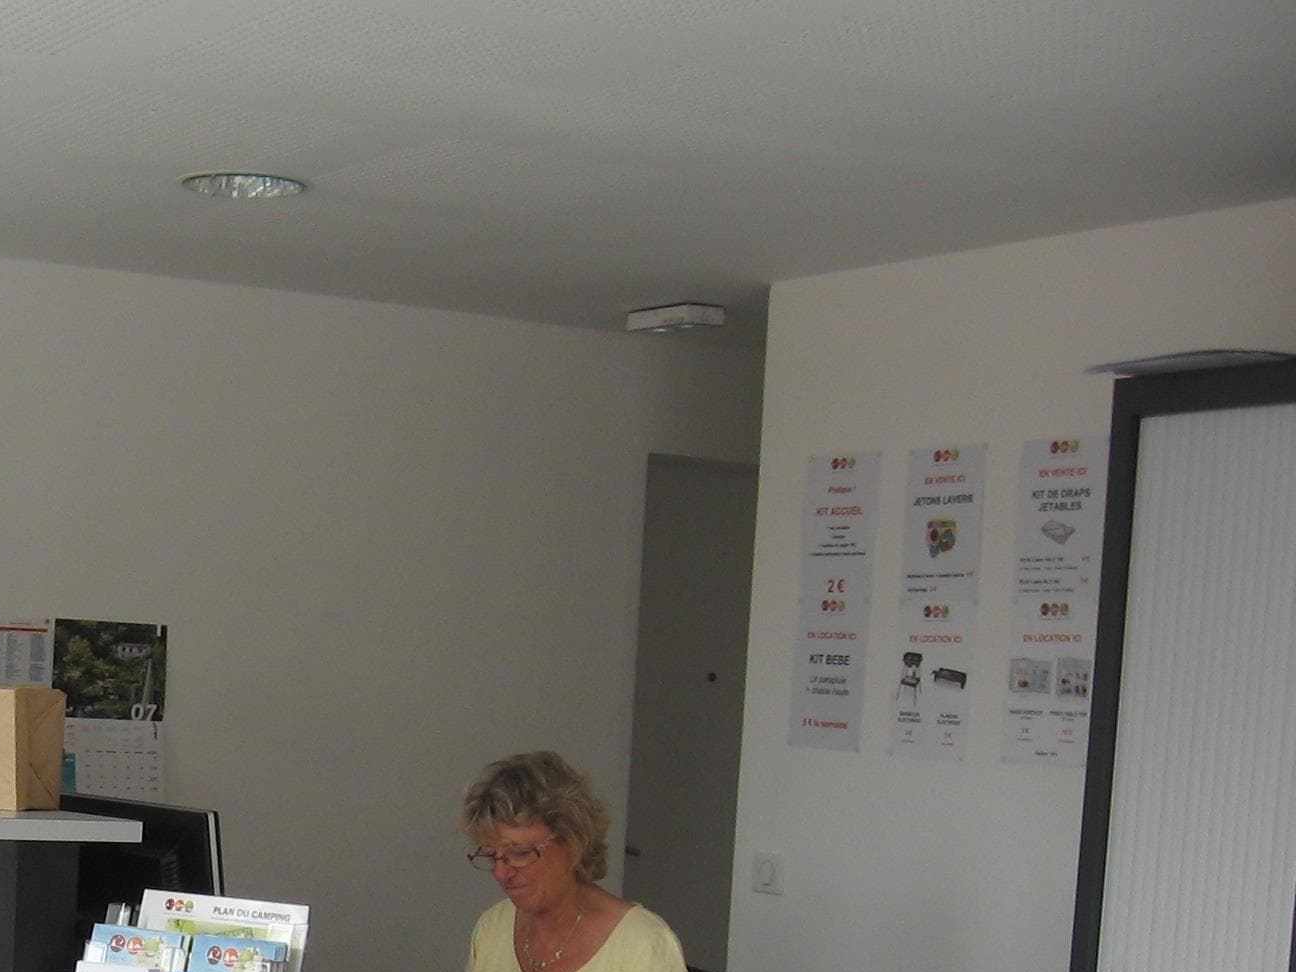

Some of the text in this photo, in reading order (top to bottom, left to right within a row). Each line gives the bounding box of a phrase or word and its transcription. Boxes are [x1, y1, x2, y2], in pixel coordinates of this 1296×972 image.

[1061, 488, 1091, 498] DRAPS
[943, 494, 974, 505] LAVERIE
[1038, 501, 1082, 512] JETABLES
[809, 654, 850, 666] KIT BEBE
[131, 703, 158, 721] 07
[212, 906, 291, 923] PLAN DU CAMPING
